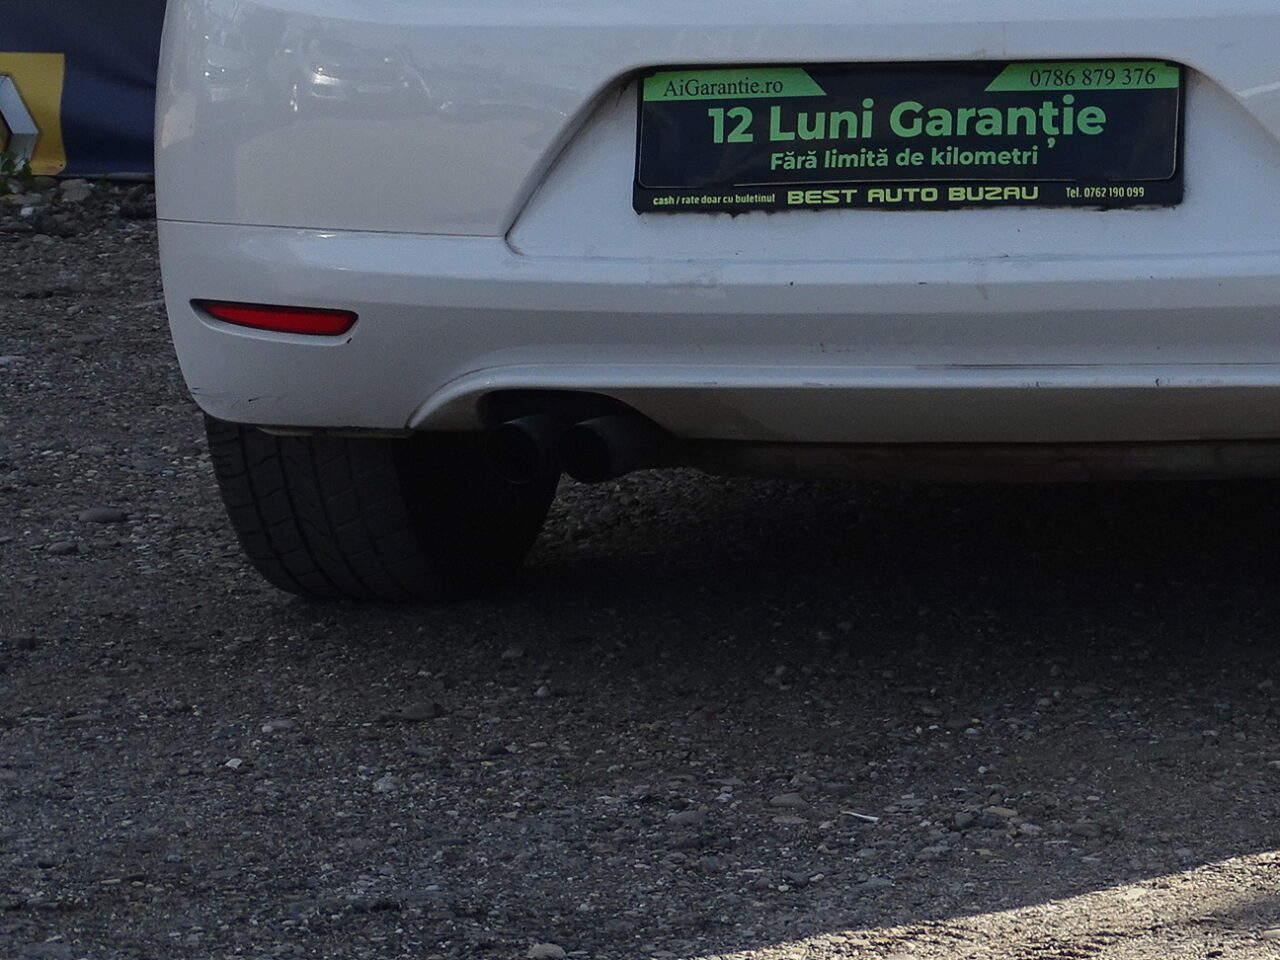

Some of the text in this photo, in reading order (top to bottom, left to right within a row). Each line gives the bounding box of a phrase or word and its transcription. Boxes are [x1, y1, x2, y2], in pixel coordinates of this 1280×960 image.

[1030, 67, 1156, 87] 0786 879 376
[663, 78, 784, 97] AiGarantie.ro
[708, 94, 1107, 148] 12 Luni Garanție
[770, 145, 1039, 171] Fără limită de kilometri
[653, 194, 675, 206] cash
[682, 194, 700, 206] rate
[701, 193, 721, 205] doar
[722, 195, 734, 204] cu
[735, 193, 776, 204] buletinul
[787, 186, 1039, 205] BEST AUTO BUZAU
[1065, 186, 1145, 198] Tel. 0762 190 099
